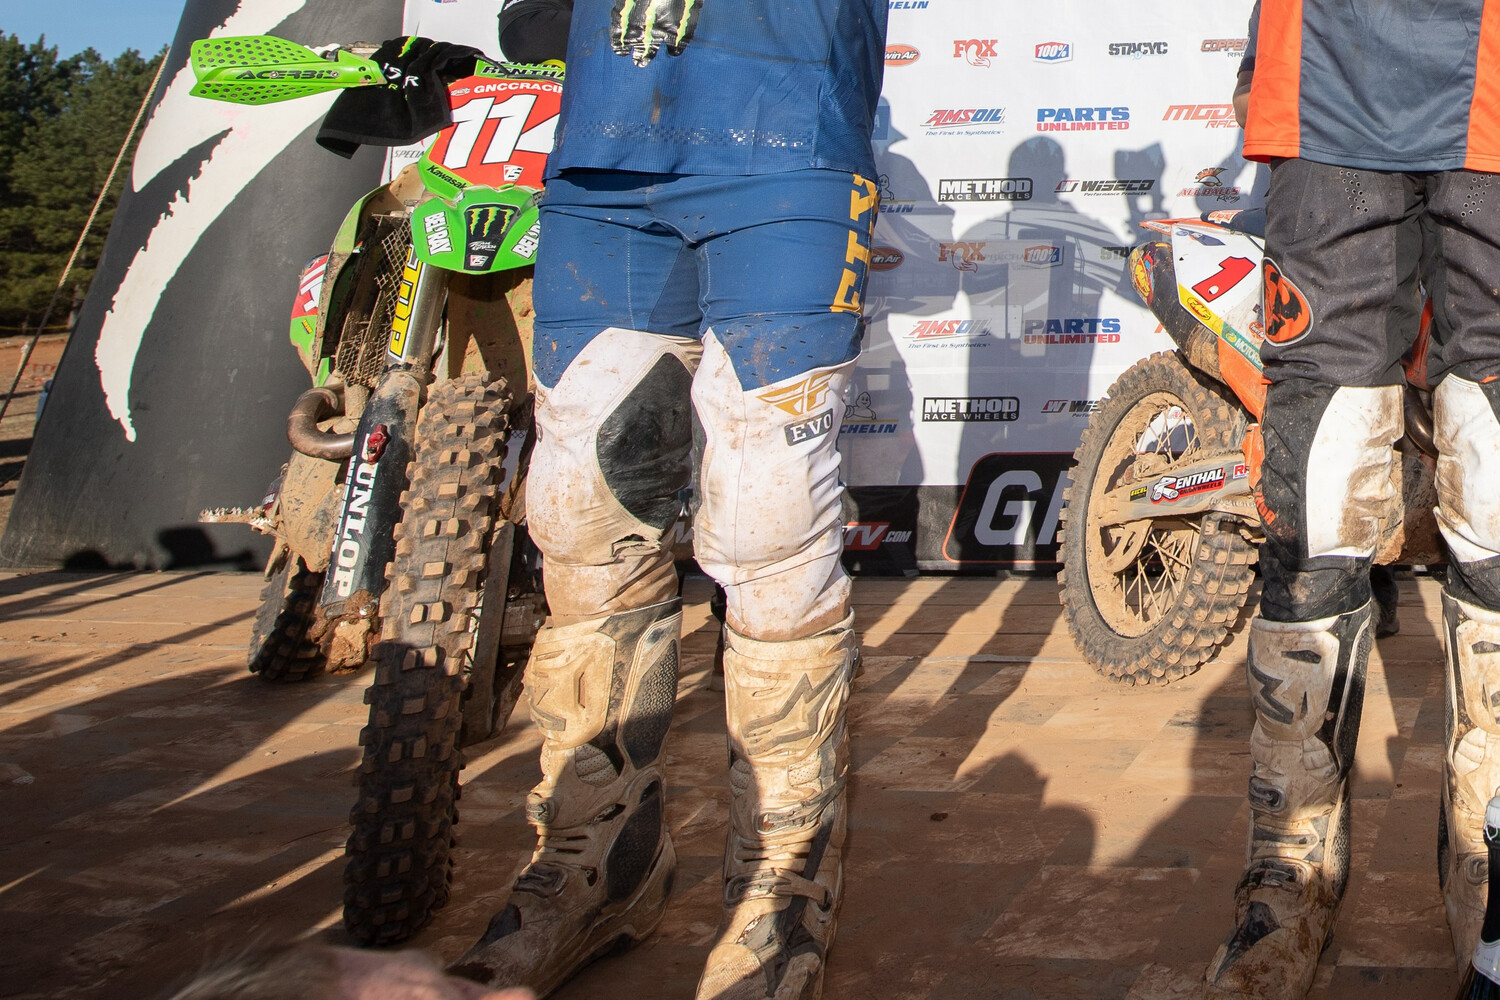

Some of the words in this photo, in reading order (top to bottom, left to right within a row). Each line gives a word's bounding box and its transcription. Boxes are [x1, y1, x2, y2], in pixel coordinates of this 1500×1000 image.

[888, 0, 930, 10] ELIN
[953, 39, 998, 58] FOX
[1036, 43, 1069, 59] 100%
[925, 107, 1004, 124] AMSOIL
[1036, 106, 1130, 121] PARTS
[1036, 120, 1130, 131] UNLIMITED
[940, 179, 1032, 194] METHOD
[940, 193, 974, 201] RACE
[981, 192, 1031, 200] WHEELS
[1024, 246, 1060, 263] 100%
[1192, 256, 1257, 303] 1
[911, 319, 991, 337] AMSOIL
[1025, 318, 1121, 334] PARTS
[1024, 333, 1121, 344] UNLIMITED
[923, 399, 1019, 413] METHOD
[923, 412, 956, 421] RACE
[963, 412, 1017, 421] WHEELS
